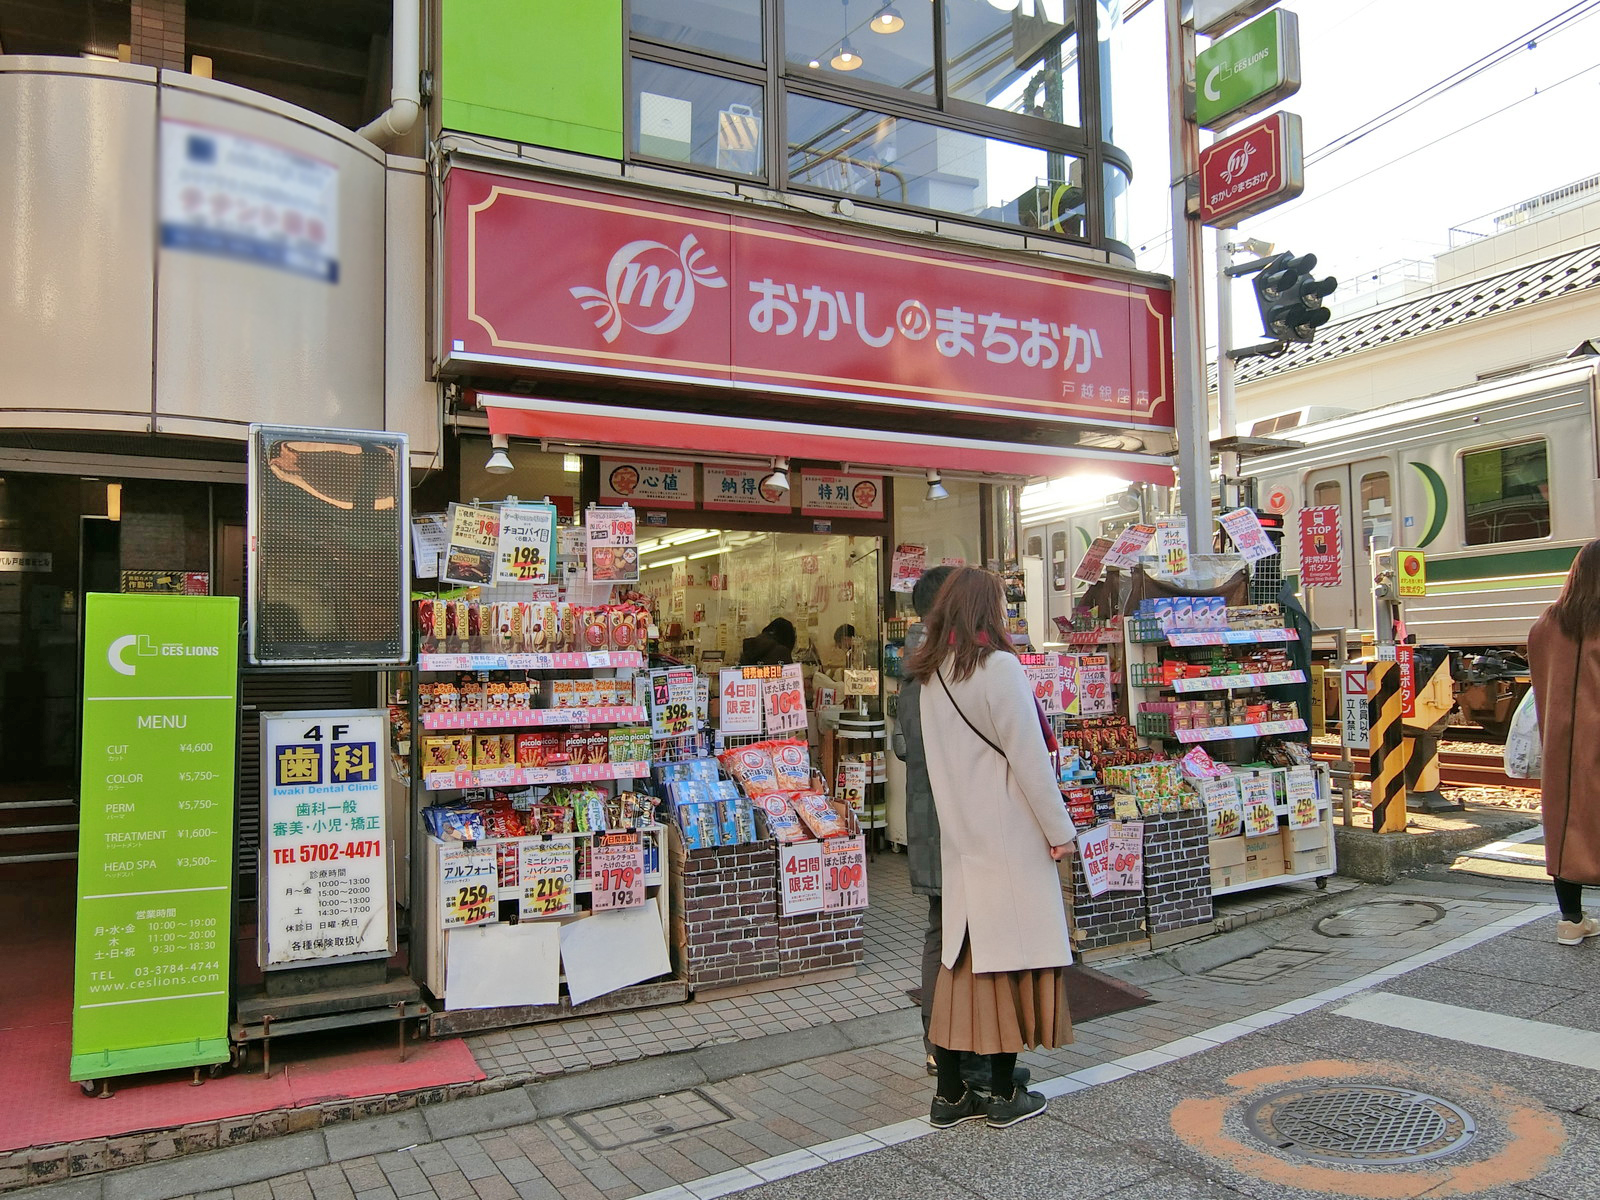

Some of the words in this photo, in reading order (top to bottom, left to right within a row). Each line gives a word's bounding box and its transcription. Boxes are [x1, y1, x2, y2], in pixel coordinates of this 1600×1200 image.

[1233, 60, 1247, 74] CES
[1248, 48, 1269, 66] LIONS
[1211, 170, 1269, 206] おかしのまちおか
[748, 277, 1103, 375] おかしのまちおか
[1062, 380, 1149, 406] 戸越銀座店
[721, 477, 757, 494] 納得
[818, 483, 849, 501] 特別
[503, 526, 540, 535] チョコパイ
[611, 521, 633, 535] 198
[1165, 530, 1180, 538] オレオ
[1307, 525, 1331, 535] STOP
[482, 536, 497, 546] 213
[616, 536, 630, 545] 213
[1163, 539, 1185, 547] クリスピー
[514, 547, 540, 564] 198
[1168, 548, 1183, 563] 119
[1304, 555, 1337, 564] 非常停止
[520, 567, 538, 579] 213
[1400, 586, 1425, 594] 非常ボタン
[161, 646, 184, 656] CES
[186, 646, 219, 656] LIONS
[1028, 672, 1057, 680] クリームコロン
[1399, 650, 1412, 714] 非常ボタン
[655, 685, 668, 698] 71
[724, 681, 756, 698] 4日間
[1036, 680, 1054, 698] 69
[1087, 683, 1105, 698] 92
[666, 704, 687, 720] 398
[727, 700, 755, 714] 限定!
[1042, 699, 1054, 711] 74
[1094, 700, 1105, 710] 99
[137, 715, 187, 729] MENU
[673, 721, 687, 732] 429
[781, 713, 799, 729] 117
[1346, 698, 1356, 742] 立入禁止
[1359, 698, 1368, 742] 係員以外
[521, 740, 541, 748] picola
[566, 737, 586, 746] picola
[588, 735, 608, 744] picola
[107, 745, 128, 755] CUT
[278, 744, 374, 784] 歯科
[106, 774, 144, 784] COLOR
[273, 787, 304, 796] Iwaki
[308, 784, 344, 794] Dental
[348, 783, 379, 792] Clinic
[105, 803, 135, 813] PERM
[296, 800, 357, 817] 歯科一般
[1253, 804, 1269, 819] 166
[1297, 798, 1312, 813] 259
[1218, 810, 1236, 826] 166
[273, 816, 380, 836] 審美・小児・矯正
[104, 830, 167, 842] TREATMENT
[273, 848, 296, 864] TEL
[300, 840, 380, 863] 5702-4471
[1110, 842, 1126, 850] ダース
[104, 861, 134, 872] HEAD
[137, 860, 157, 870] SPA
[785, 856, 820, 875] 4日間
[1115, 853, 1136, 872] 69
[309, 868, 347, 880] 診療時間
[444, 863, 496, 879] アルフォート
[830, 864, 862, 891] 109
[602, 867, 634, 891] 179
[789, 874, 819, 893] 限定!
[1121, 874, 1134, 886] 74
[538, 877, 564, 898] 219
[459, 885, 488, 907] 259
[612, 891, 633, 907] 193
[840, 890, 859, 907] 117
[294, 907, 303, 915] 土
[545, 898, 562, 911] 236
[136, 908, 177, 920] 営業時間
[468, 906, 487, 921] 279
[285, 923, 313, 933] 休診日
[109, 938, 119, 946] 木
[291, 936, 364, 952] 各種保険取扱い
[91, 971, 115, 981] TEL
[135, 961, 219, 977] 03-3784-4744
[90, 973, 219, 993] www.ceslions.com
